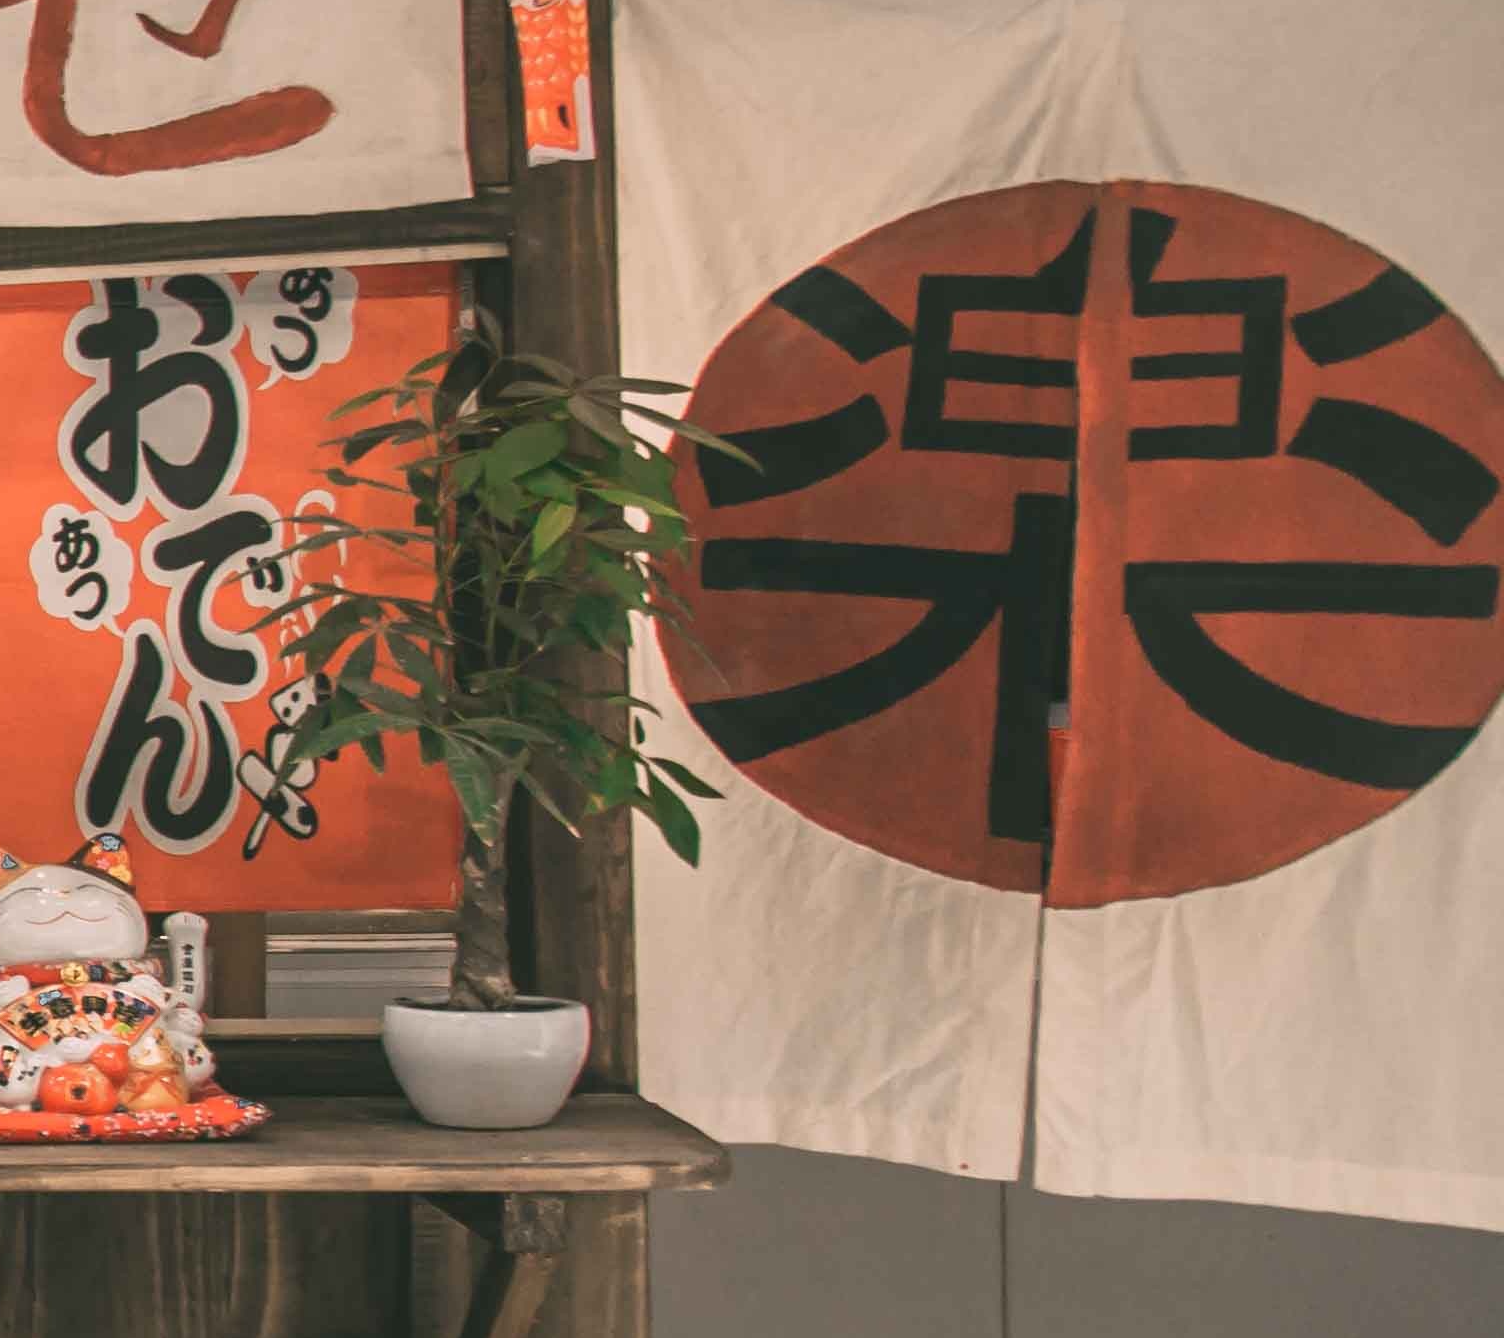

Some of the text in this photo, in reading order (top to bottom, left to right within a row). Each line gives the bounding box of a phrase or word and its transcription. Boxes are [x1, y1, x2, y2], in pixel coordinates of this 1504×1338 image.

[51, 517, 110, 621] あつ
[71, 273, 285, 842] おでん
[684, 204, 1502, 847] 楽
